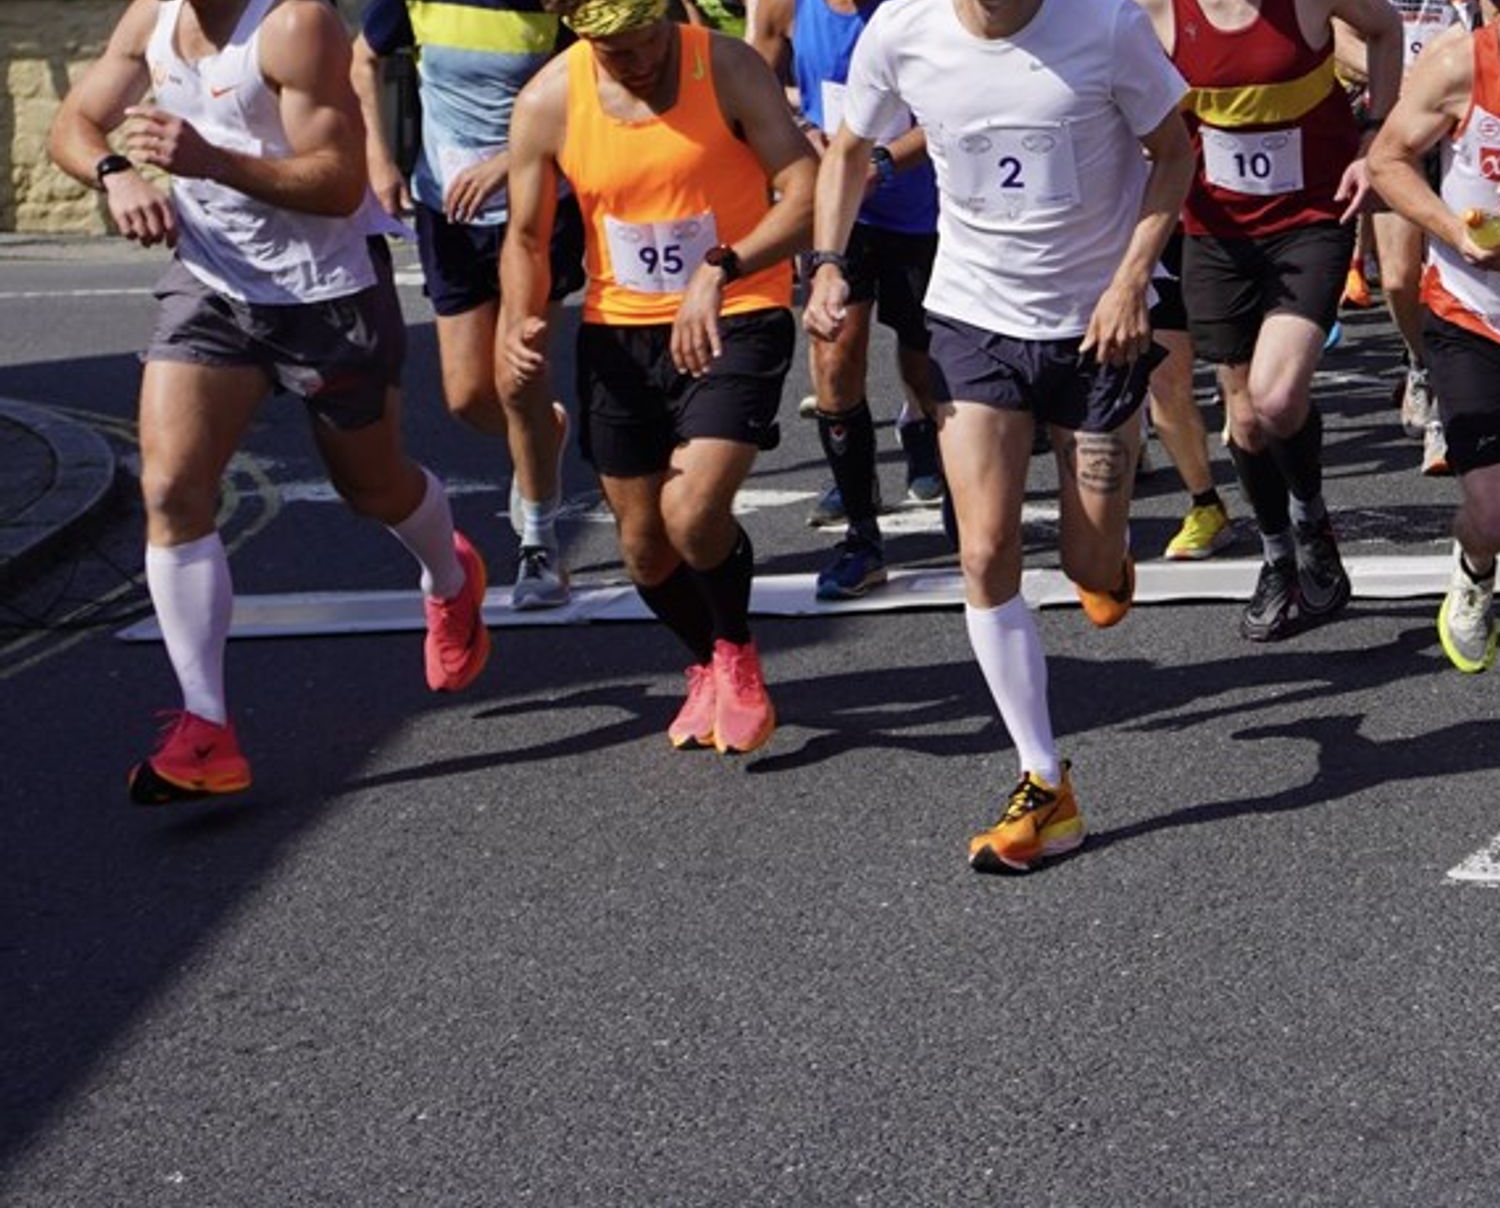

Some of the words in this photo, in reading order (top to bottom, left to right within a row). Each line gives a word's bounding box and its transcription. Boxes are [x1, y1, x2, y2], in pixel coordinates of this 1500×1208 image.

[998, 155, 1025, 189] 2
[1233, 152, 1271, 179] 10
[639, 244, 684, 275] 95
